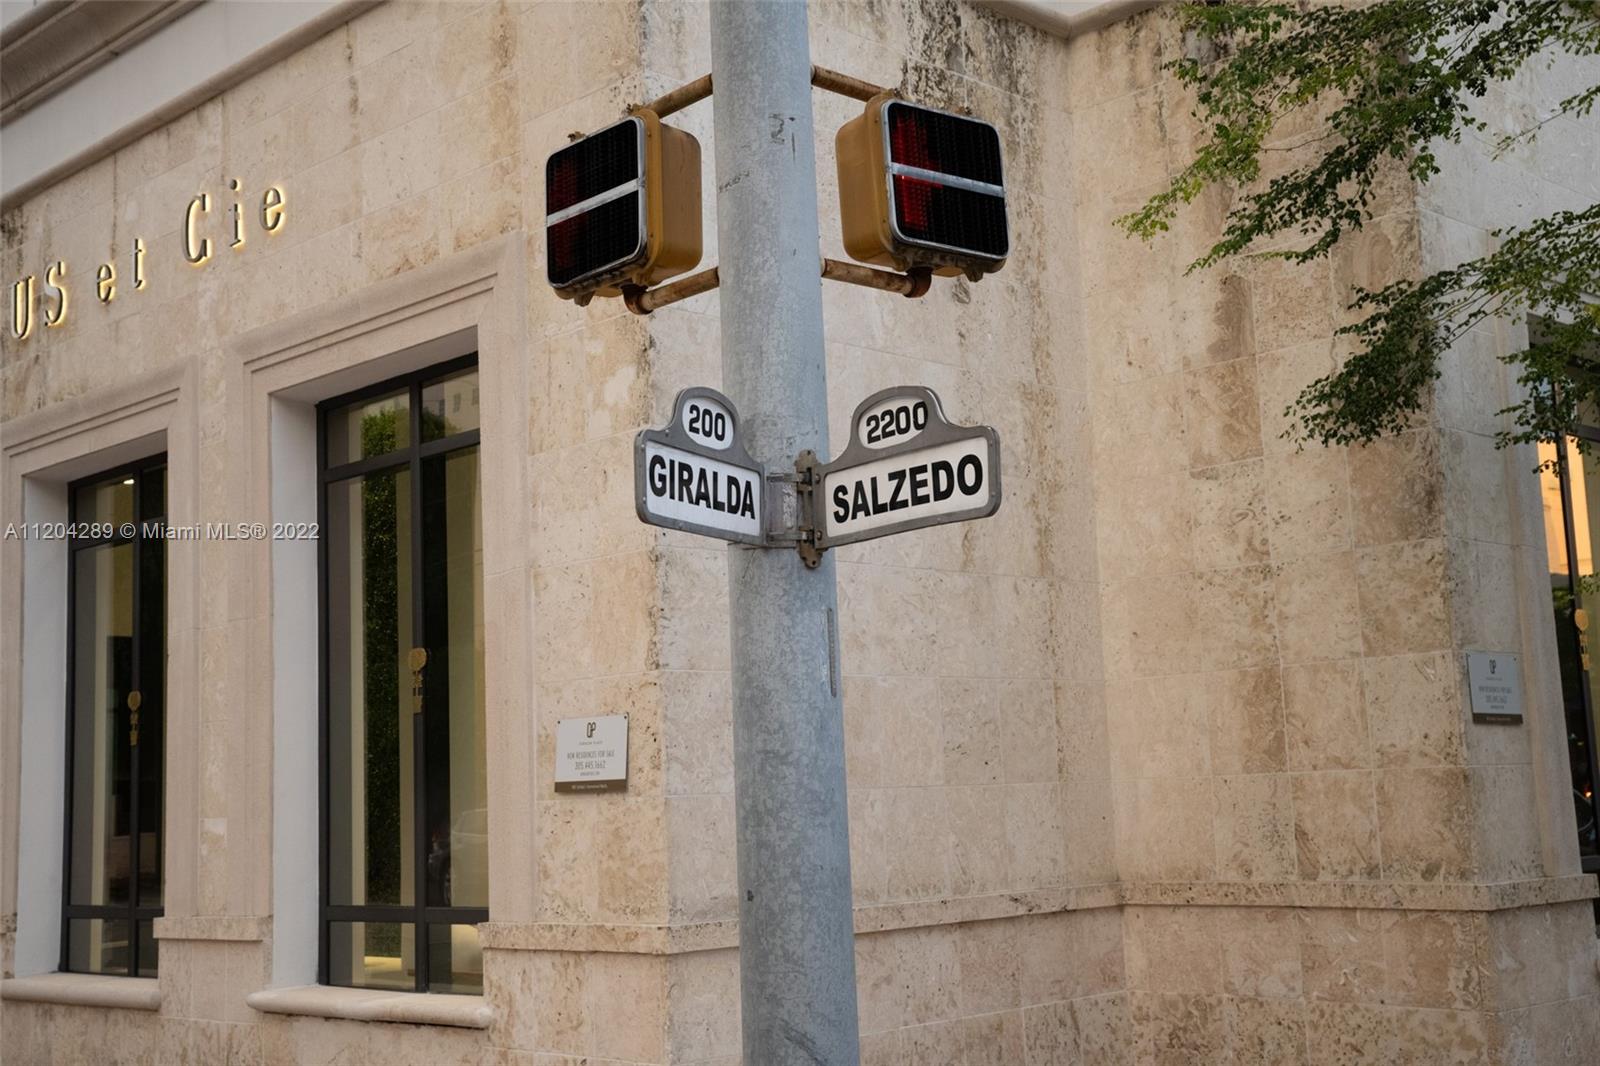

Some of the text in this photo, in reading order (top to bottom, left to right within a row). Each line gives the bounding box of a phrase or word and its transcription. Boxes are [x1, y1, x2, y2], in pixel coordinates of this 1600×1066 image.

[97, 238, 145, 304] et
[181, 178, 286, 265] Cie
[687, 403, 727, 442] 200
[866, 400, 929, 445] 2200
[649, 454, 756, 520] GIRALDA
[832, 453, 984, 524] SALZEDO
